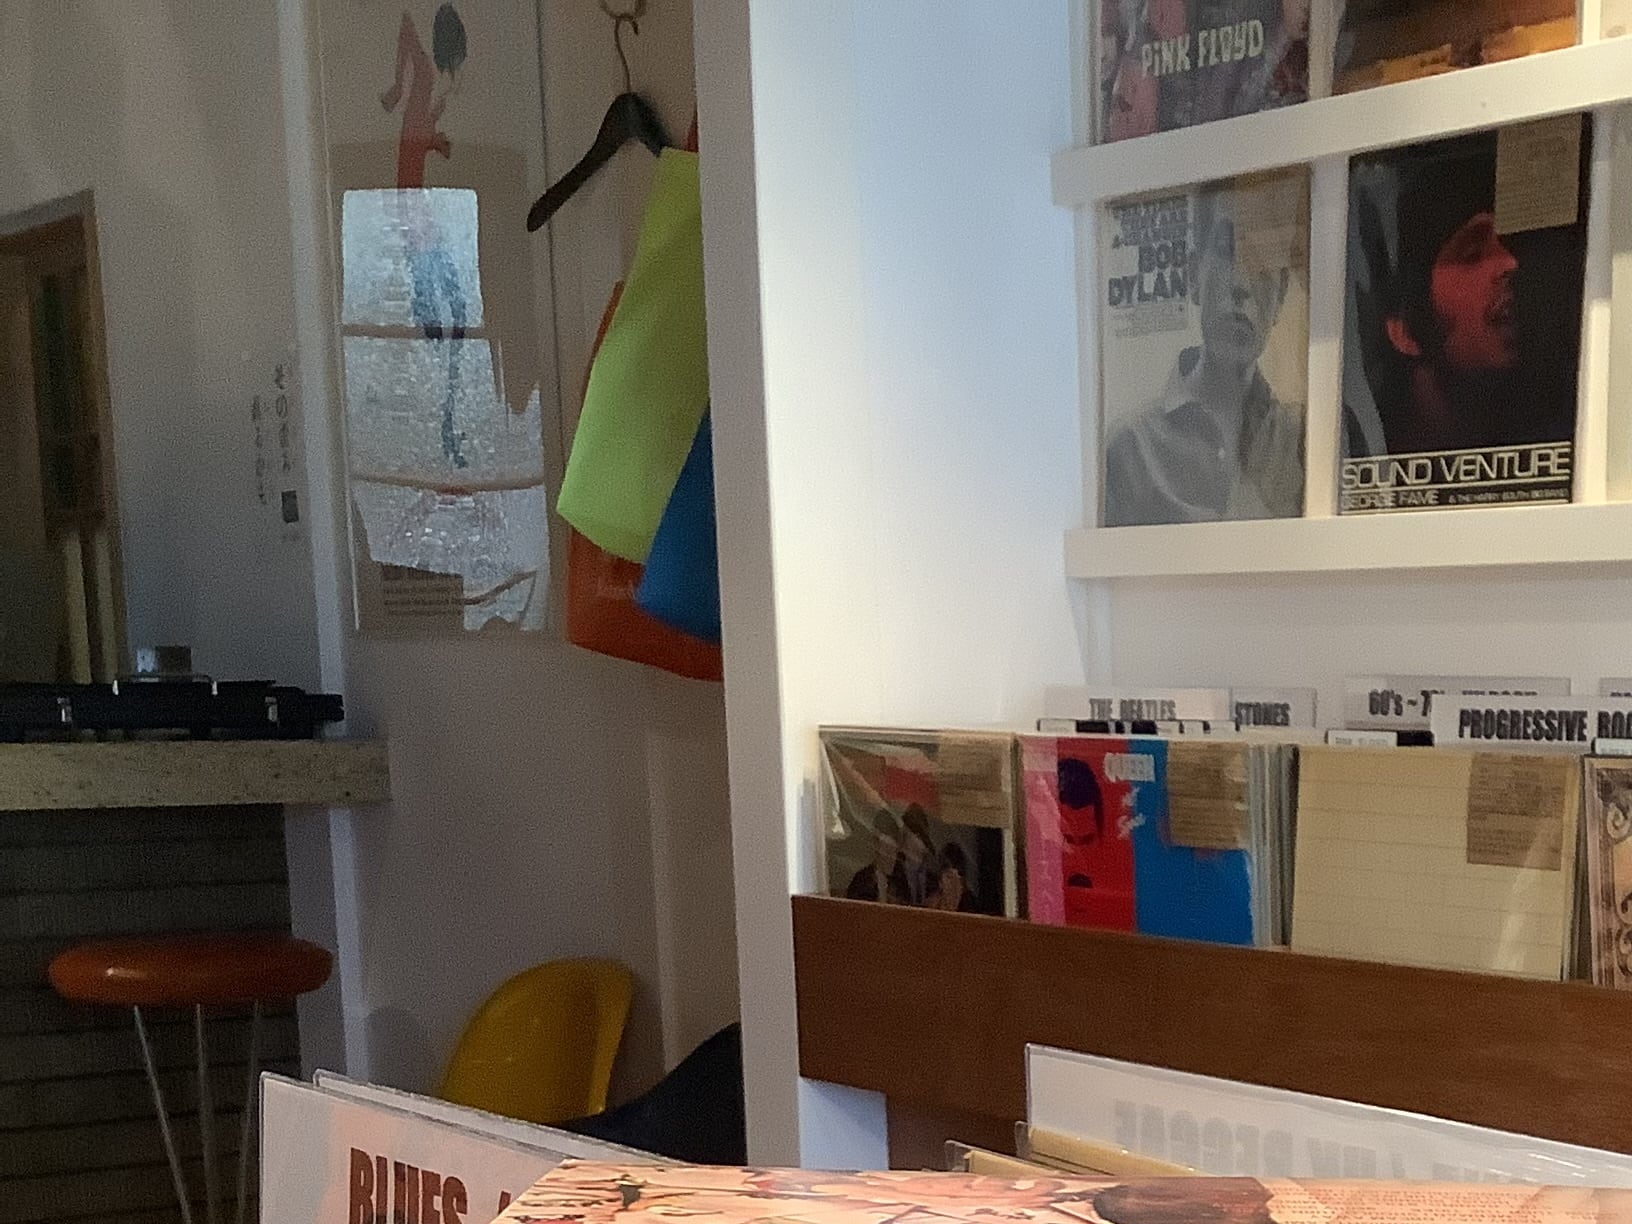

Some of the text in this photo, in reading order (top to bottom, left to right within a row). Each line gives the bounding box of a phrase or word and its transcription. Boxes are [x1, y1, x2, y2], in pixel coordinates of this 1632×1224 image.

[1198, 19, 1264, 68] FLOYD
[1341, 447, 1571, 490] SOUND VENTURE
[1235, 700, 1291, 726] STONES
[1458, 708, 1589, 742] PROGRESSIVE
